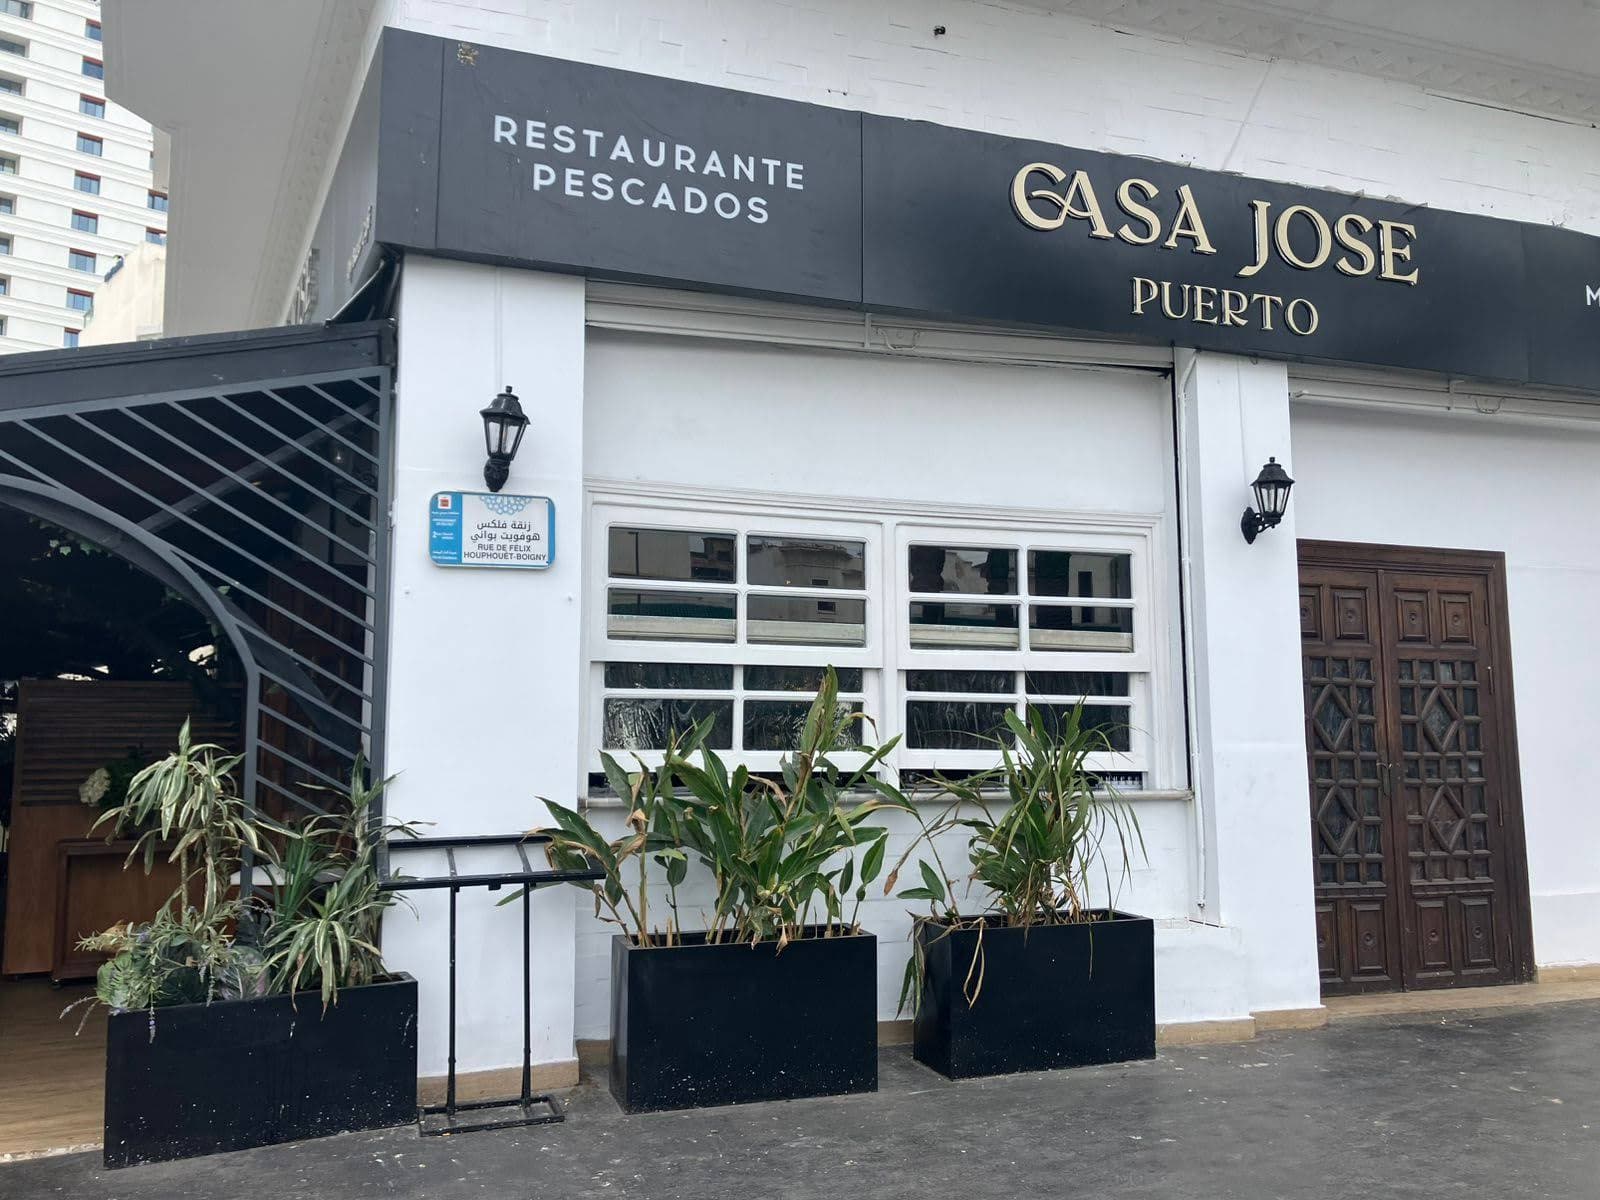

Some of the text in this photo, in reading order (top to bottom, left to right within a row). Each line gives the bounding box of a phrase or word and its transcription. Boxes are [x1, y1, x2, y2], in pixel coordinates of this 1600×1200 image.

[494, 114, 804, 190] RESTAURANTE
[533, 163, 769, 224] PESCADOS
[1010, 161, 1419, 286] CASA JOSE
[1131, 276, 1319, 336] PUERTO
[477, 543, 494, 551] RUE
[509, 544, 531, 552] FELIX
[511, 520, 531, 532] زنقة
